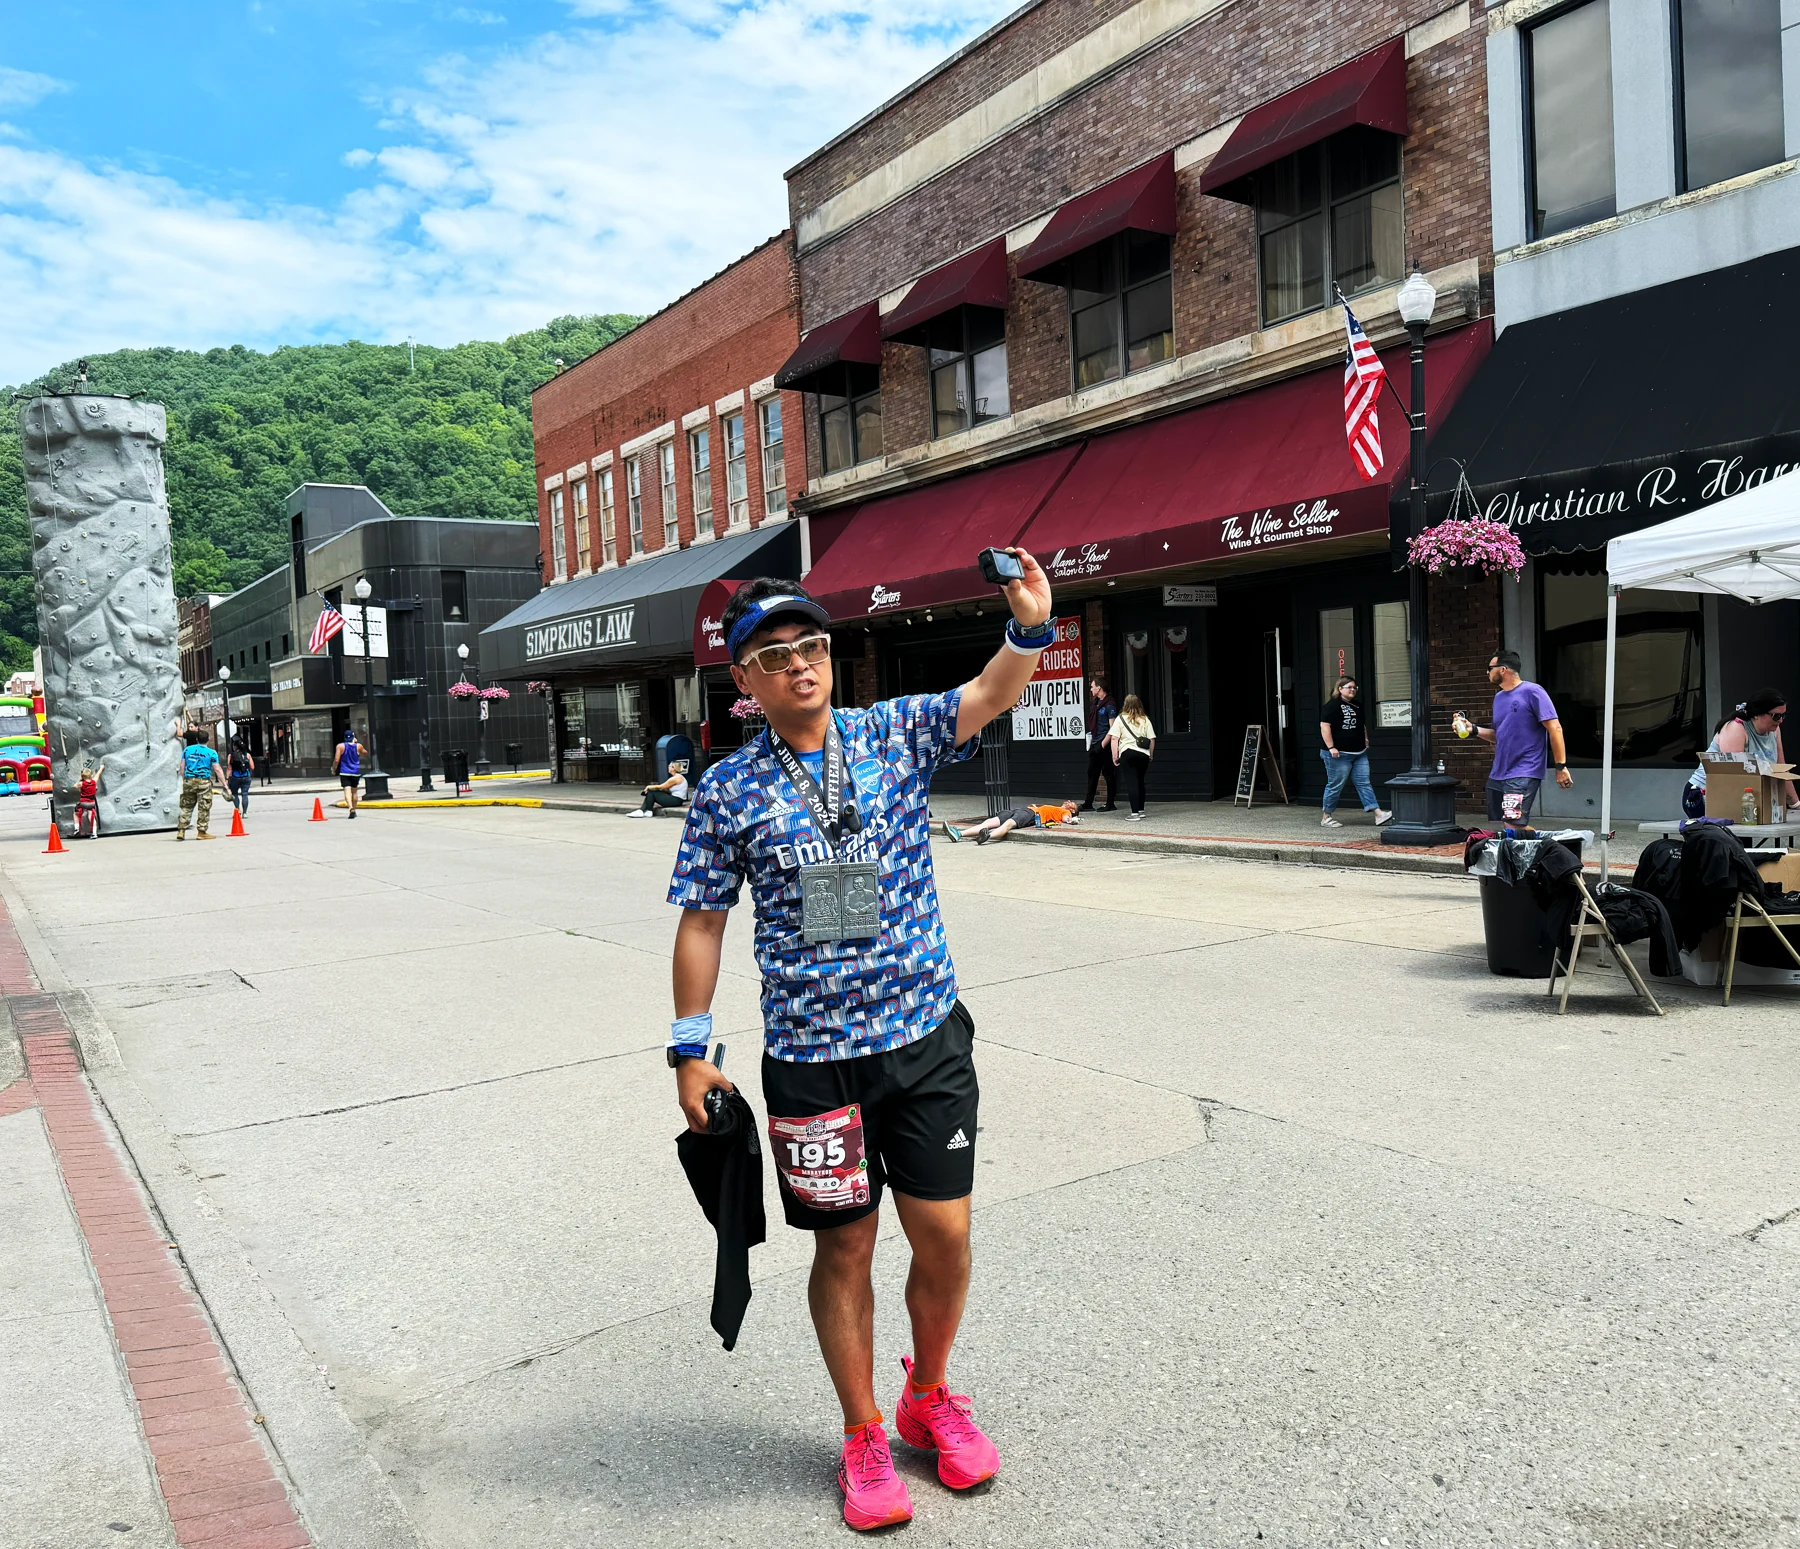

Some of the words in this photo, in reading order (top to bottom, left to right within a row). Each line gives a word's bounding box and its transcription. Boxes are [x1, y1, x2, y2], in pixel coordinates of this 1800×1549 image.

[1486, 488, 1630, 530] Christian
[1637, 467, 1686, 508] R.
[1221, 516, 1244, 542] The
[1250, 509, 1283, 538] Wine
[1288, 499, 1340, 528] Seller
[1229, 539, 1251, 550] Wine
[1254, 536, 1261, 545] &
[1263, 528, 1304, 543] Gourmet
[1306, 525, 1333, 536] Shop
[1046, 548, 1076, 570] Mane
[1078, 543, 1111, 564] Street
[1054, 567, 1077, 578] Salon
[1086, 563, 1102, 575] Spa
[526, 617, 592, 658] SIMPKINS
[596, 608, 635, 644] LAW
[1043, 647, 1080, 671] RIDERS
[1022, 683, 1042, 707] OW
[1047, 680, 1080, 706] OPEN
[1041, 707, 1053, 716] FOR
[1349, 718, 1357, 729] TO
[1029, 718, 1053, 738] DINE
[1057, 717, 1067, 736] IN
[828, 736, 838, 748] &
[857, 763, 878, 775] Arsenal
[777, 746, 803, 780] JUNE
[798, 779, 810, 794] 8,
[808, 794, 831, 828] 2024
[828, 752, 839, 824] HATFIELD
[766, 806, 796, 818] adidas
[786, 1137, 846, 1168] 195
[946, 1139, 970, 1150] adidas
